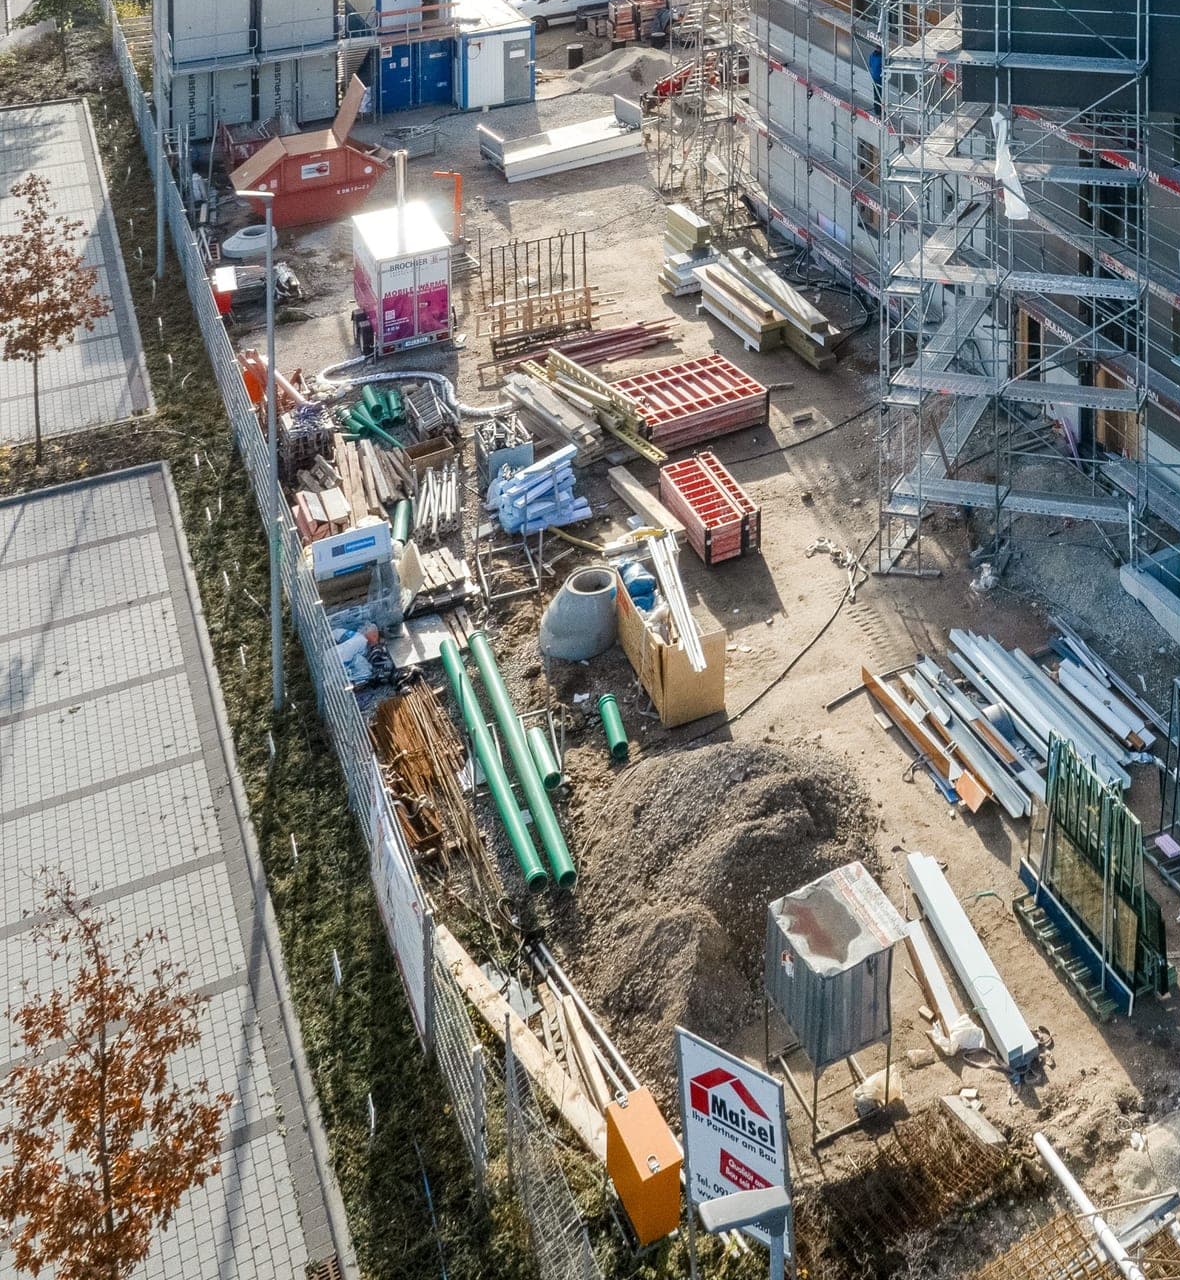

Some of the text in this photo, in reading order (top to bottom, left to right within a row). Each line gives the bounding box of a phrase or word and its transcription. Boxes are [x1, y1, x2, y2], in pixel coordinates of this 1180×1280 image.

[692, 1110, 776, 1164] Ihr Partner am Bau
[712, 1094, 776, 1148] Maisel
[696, 1172, 711, 1189] Tel.
